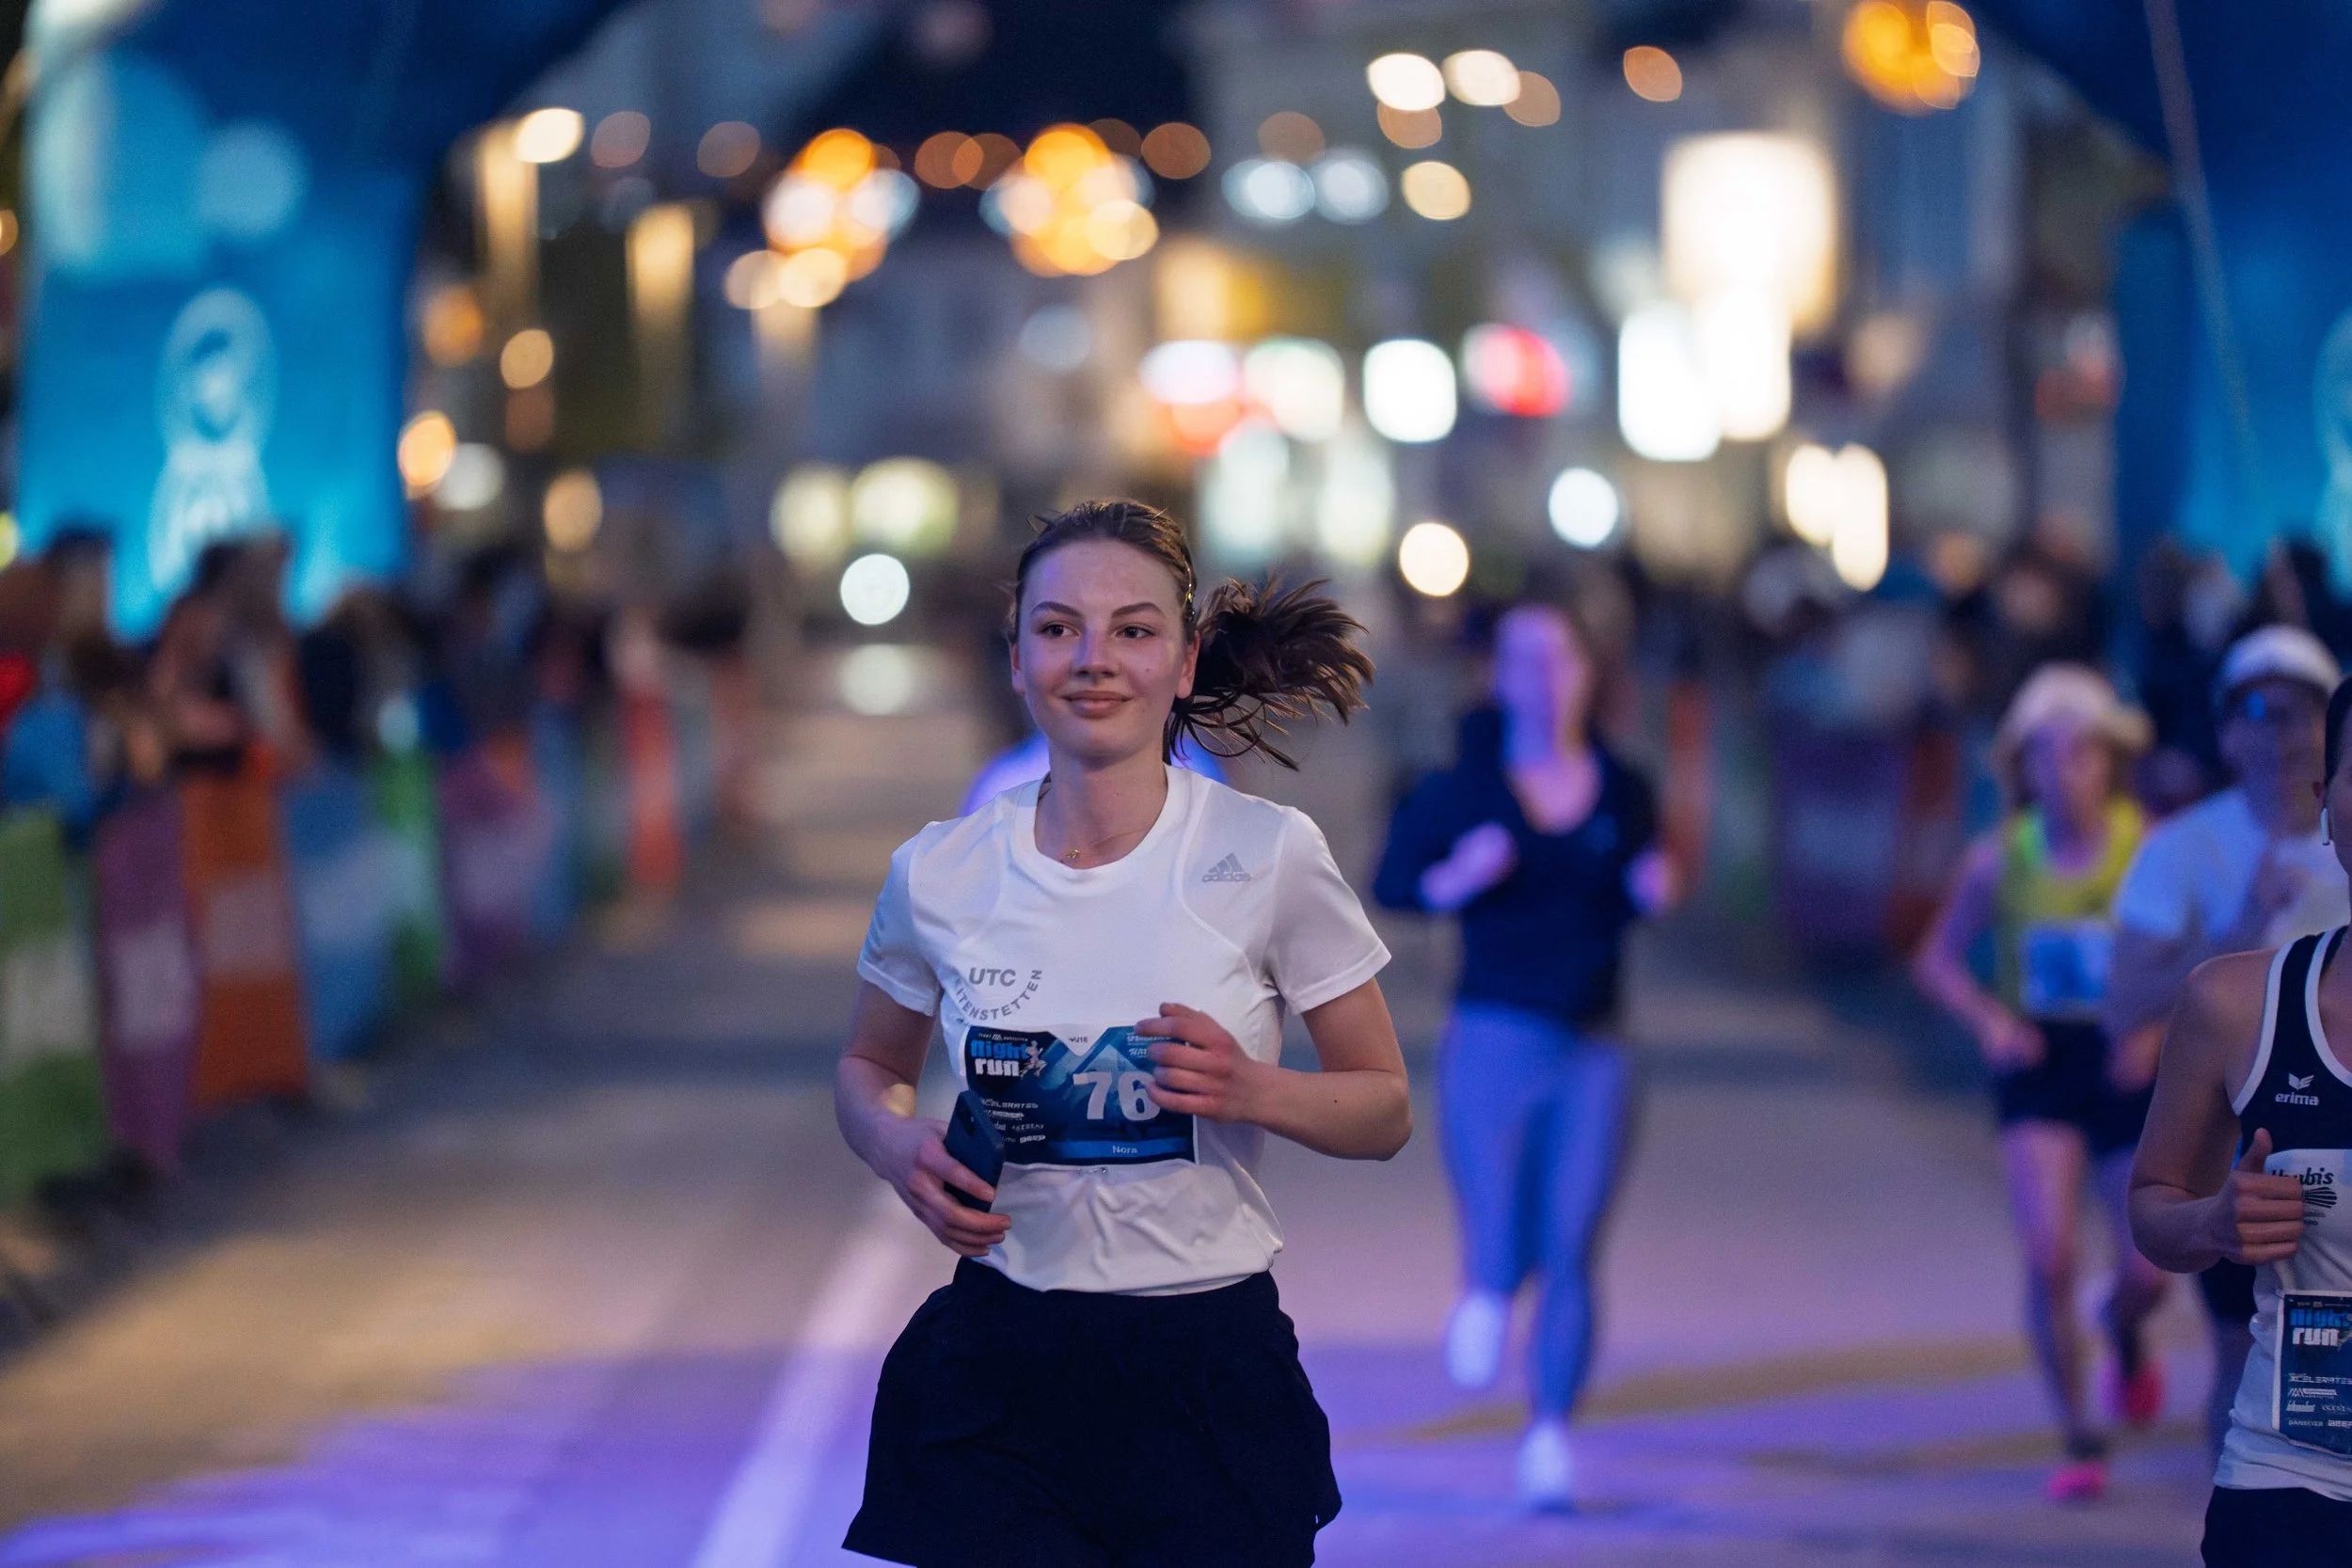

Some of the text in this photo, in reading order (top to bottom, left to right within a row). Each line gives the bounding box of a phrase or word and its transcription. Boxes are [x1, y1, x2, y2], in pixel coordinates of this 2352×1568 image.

[969, 967, 1017, 987] UTC
[955, 970, 1042, 1021] ITENSTETTEN
[975, 1058, 1020, 1076] run
[1073, 1070, 1161, 1120] 76
[2275, 1091, 2318, 1105] erima
[1112, 1145, 1137, 1154] Nora
[2272, 1167, 2334, 1185] ubis
[2292, 1327, 2339, 1346] run
